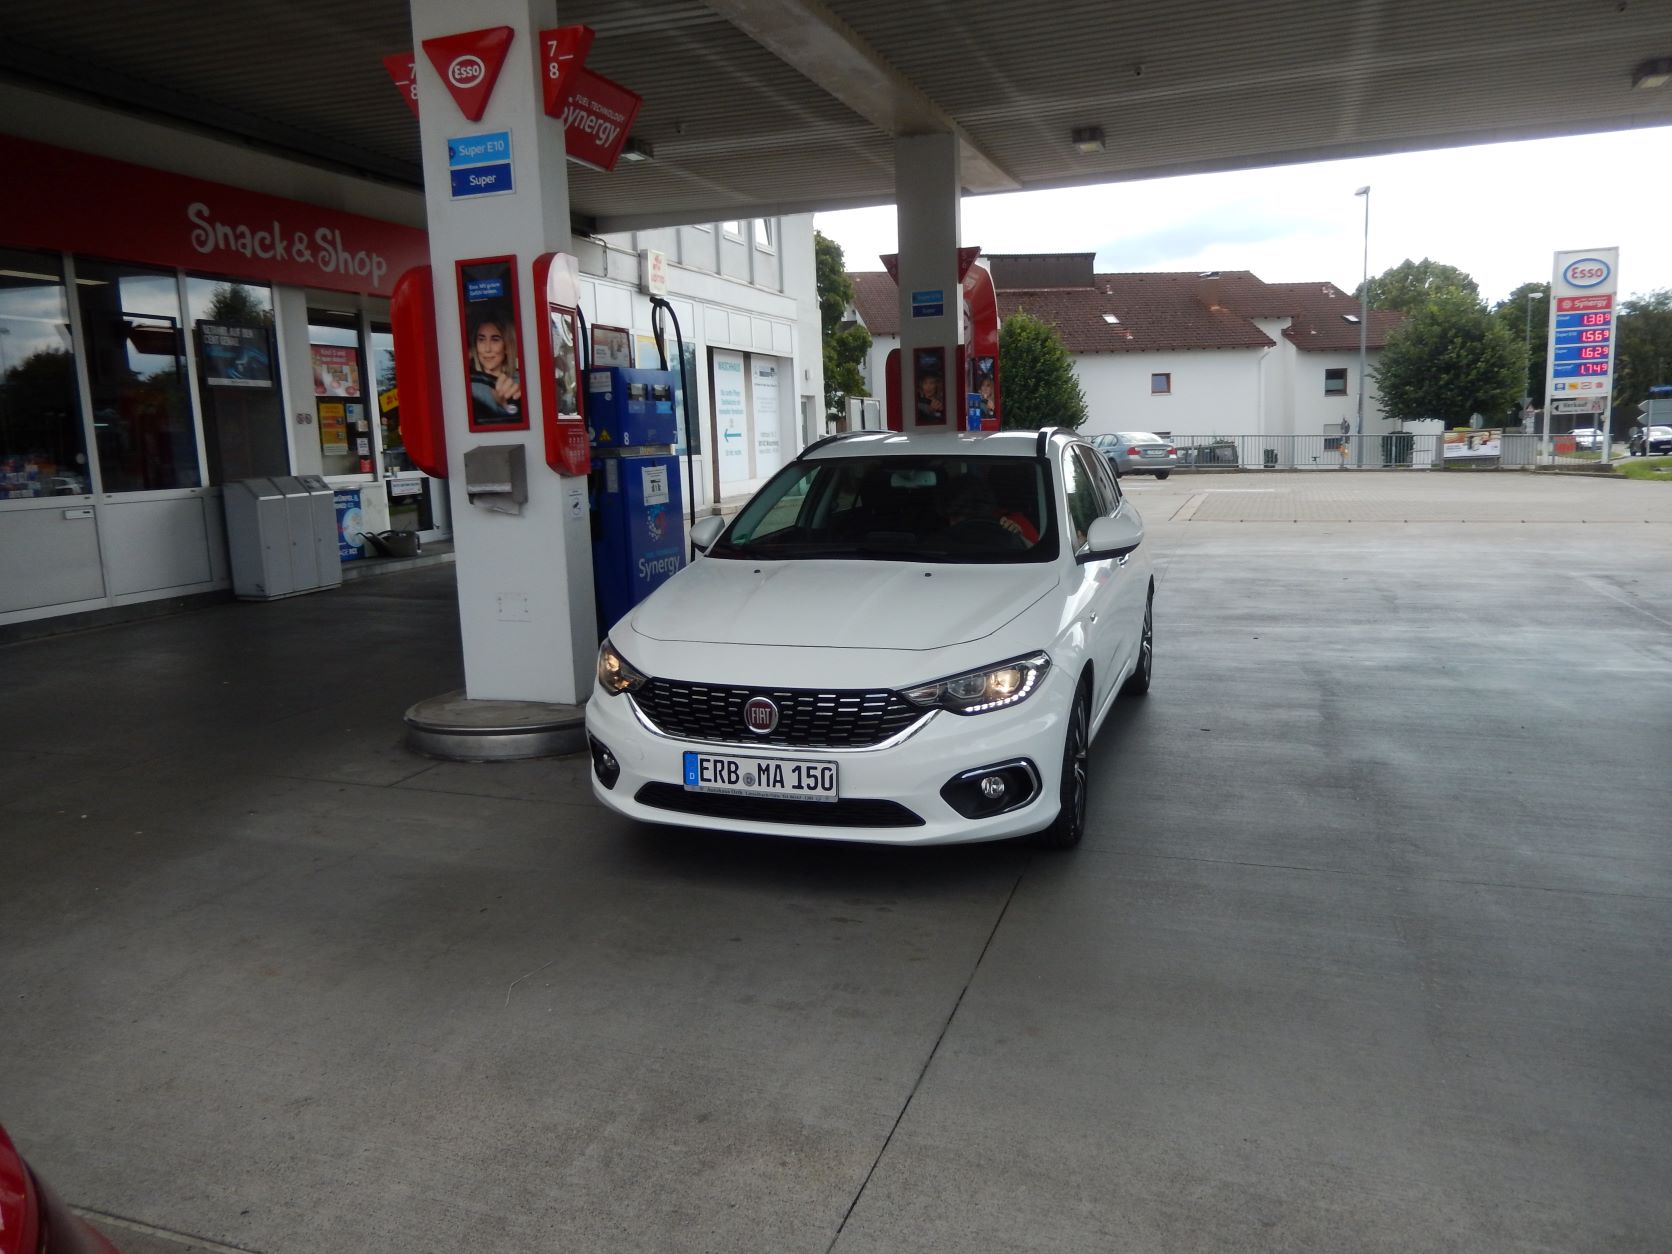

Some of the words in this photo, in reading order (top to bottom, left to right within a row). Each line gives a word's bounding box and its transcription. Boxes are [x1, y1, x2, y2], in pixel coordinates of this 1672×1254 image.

[548, 41, 557, 56] 7
[454, 65, 480, 79] Esso
[549, 63, 559, 78] 8
[576, 94, 589, 108] FUEL
[591, 101, 625, 123] TECHNOLOGY
[459, 145, 485, 158] Super
[487, 141, 505, 152] E10
[469, 174, 496, 187] Super
[187, 202, 288, 261] Snack
[292, 232, 314, 263] &
[315, 227, 387, 288] Shop
[1571, 267, 1604, 279] Esso
[1574, 300, 1608, 309] Synergy
[624, 432, 631, 445] 8
[638, 556, 680, 582] Synergy
[752, 707, 771, 724] FIAT
[700, 759, 740, 785] ERB
[757, 762, 785, 788] MA
[791, 765, 834, 791] 150
